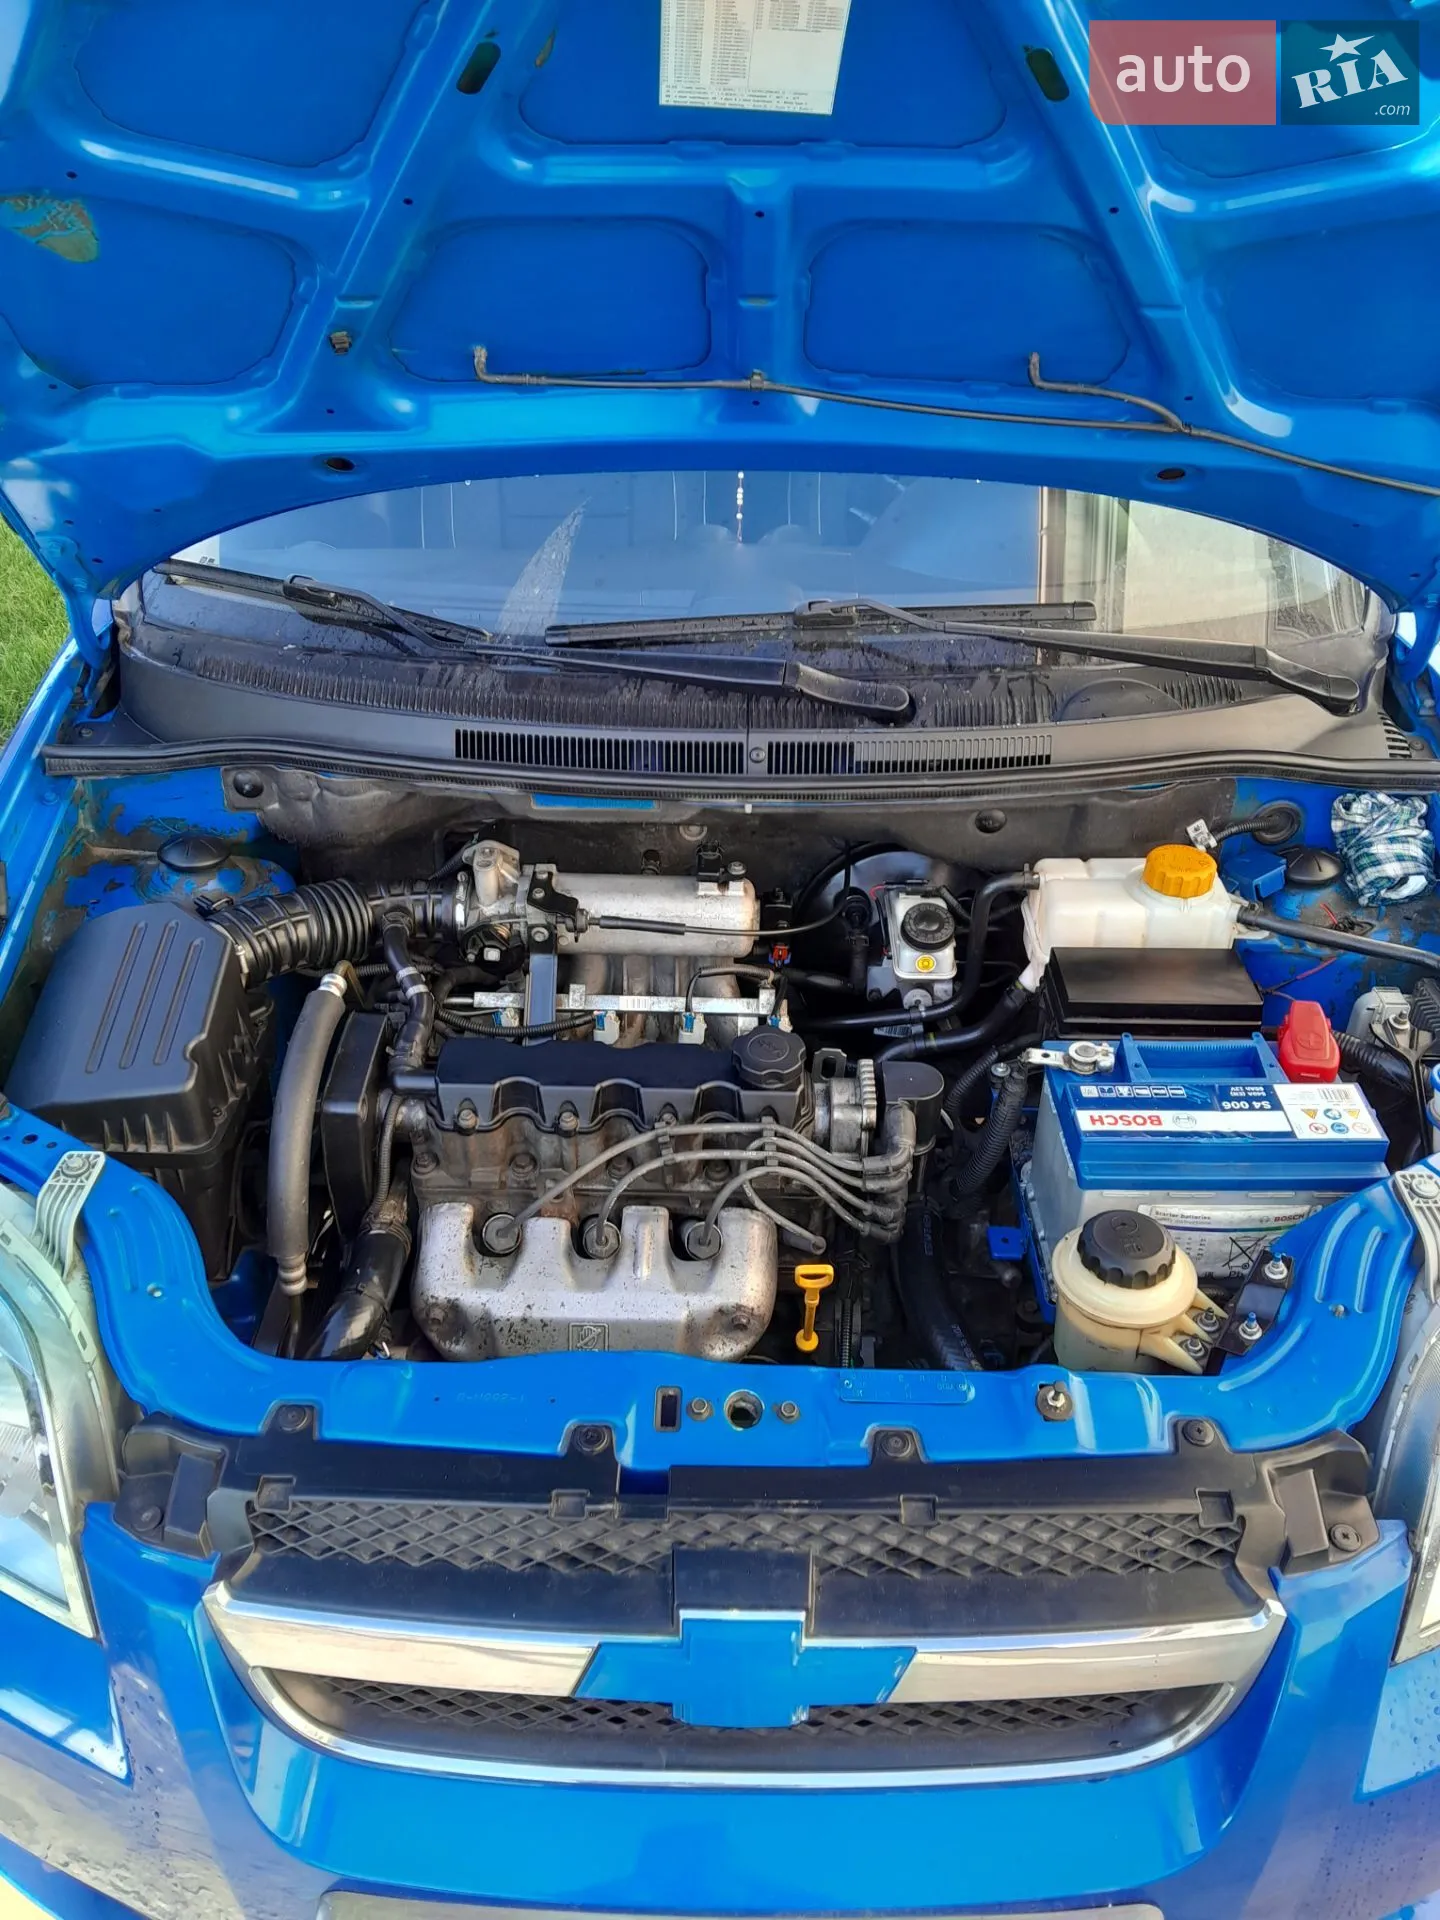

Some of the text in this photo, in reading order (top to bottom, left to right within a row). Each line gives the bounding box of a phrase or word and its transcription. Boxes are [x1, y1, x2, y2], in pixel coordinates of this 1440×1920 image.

[1221, 1100, 1272, 1110] S4 006
[1089, 1114, 1163, 1126] BOSCH
[1155, 1210, 1179, 1218] Starter
[1273, 1212, 1305, 1223] BOSCH
